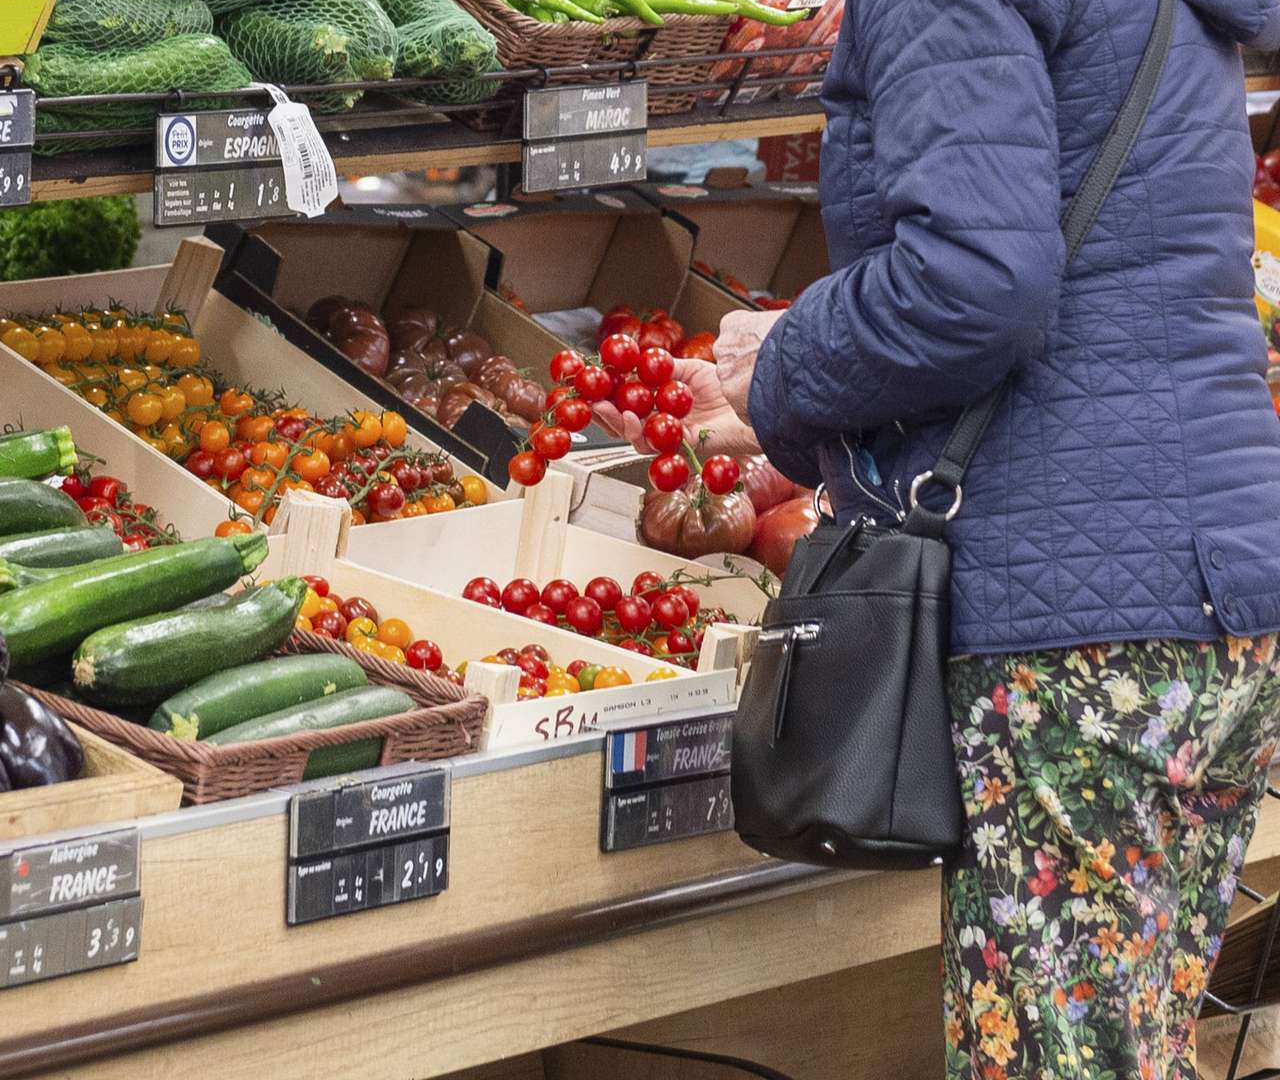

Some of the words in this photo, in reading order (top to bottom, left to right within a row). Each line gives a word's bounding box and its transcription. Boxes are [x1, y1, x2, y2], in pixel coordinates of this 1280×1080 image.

[606, 87, 621, 99] Vert
[227, 114, 265, 129] Courgette
[585, 107, 632, 130] MAROC
[172, 140, 188, 149] PRIX
[224, 135, 281, 159] ESPAGN
[656, 726, 681, 743] Tomate
[682, 722, 707, 739] Cerise
[371, 781, 413, 802] Courgette
[369, 800, 427, 835] FRANCE
[49, 842, 99, 865] Aubergine
[49, 864, 118, 903] FRANCE
